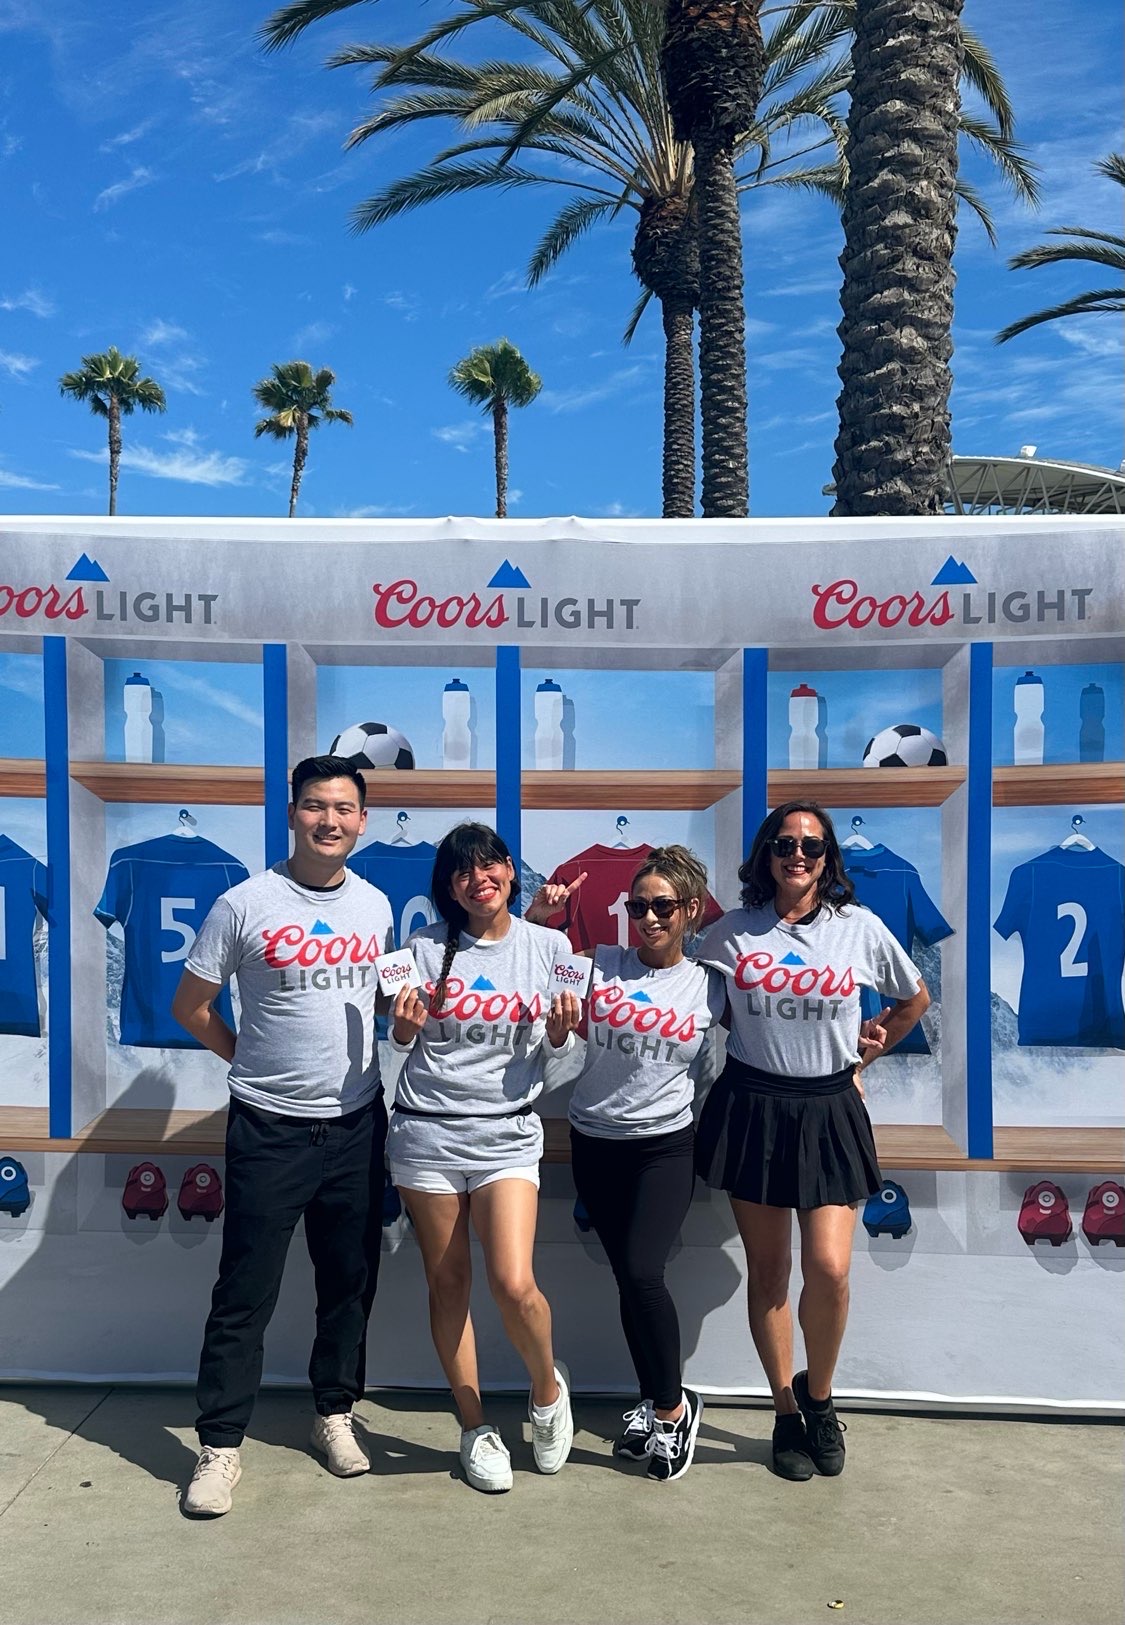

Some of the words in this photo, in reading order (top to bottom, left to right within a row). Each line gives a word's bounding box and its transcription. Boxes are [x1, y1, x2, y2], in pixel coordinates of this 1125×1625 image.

[0, 584, 89, 620] oors
[96, 590, 219, 625] LIGHT
[373, 579, 510, 629] Coors
[517, 597, 642, 630] LIGHT
[811, 579, 954, 630] Coors
[963, 588, 1093, 625] LIGHT
[160, 897, 197, 963] 5
[262, 925, 382, 969] Coors
[1056, 902, 1089, 978] 2
[280, 966, 371, 991] LIGHT
[380, 963, 412, 978] Coors
[387, 973, 410, 984] LIGHT
[554, 964, 585, 980] Coors
[555, 975, 580, 986] LIGHT
[735, 951, 855, 997] Coors
[425, 978, 542, 1023] Coors
[590, 983, 695, 1042] Coors
[747, 993, 843, 1020] LIGHT
[439, 1022, 528, 1046] LIGHT
[595, 1025, 680, 1062] LIGHT
